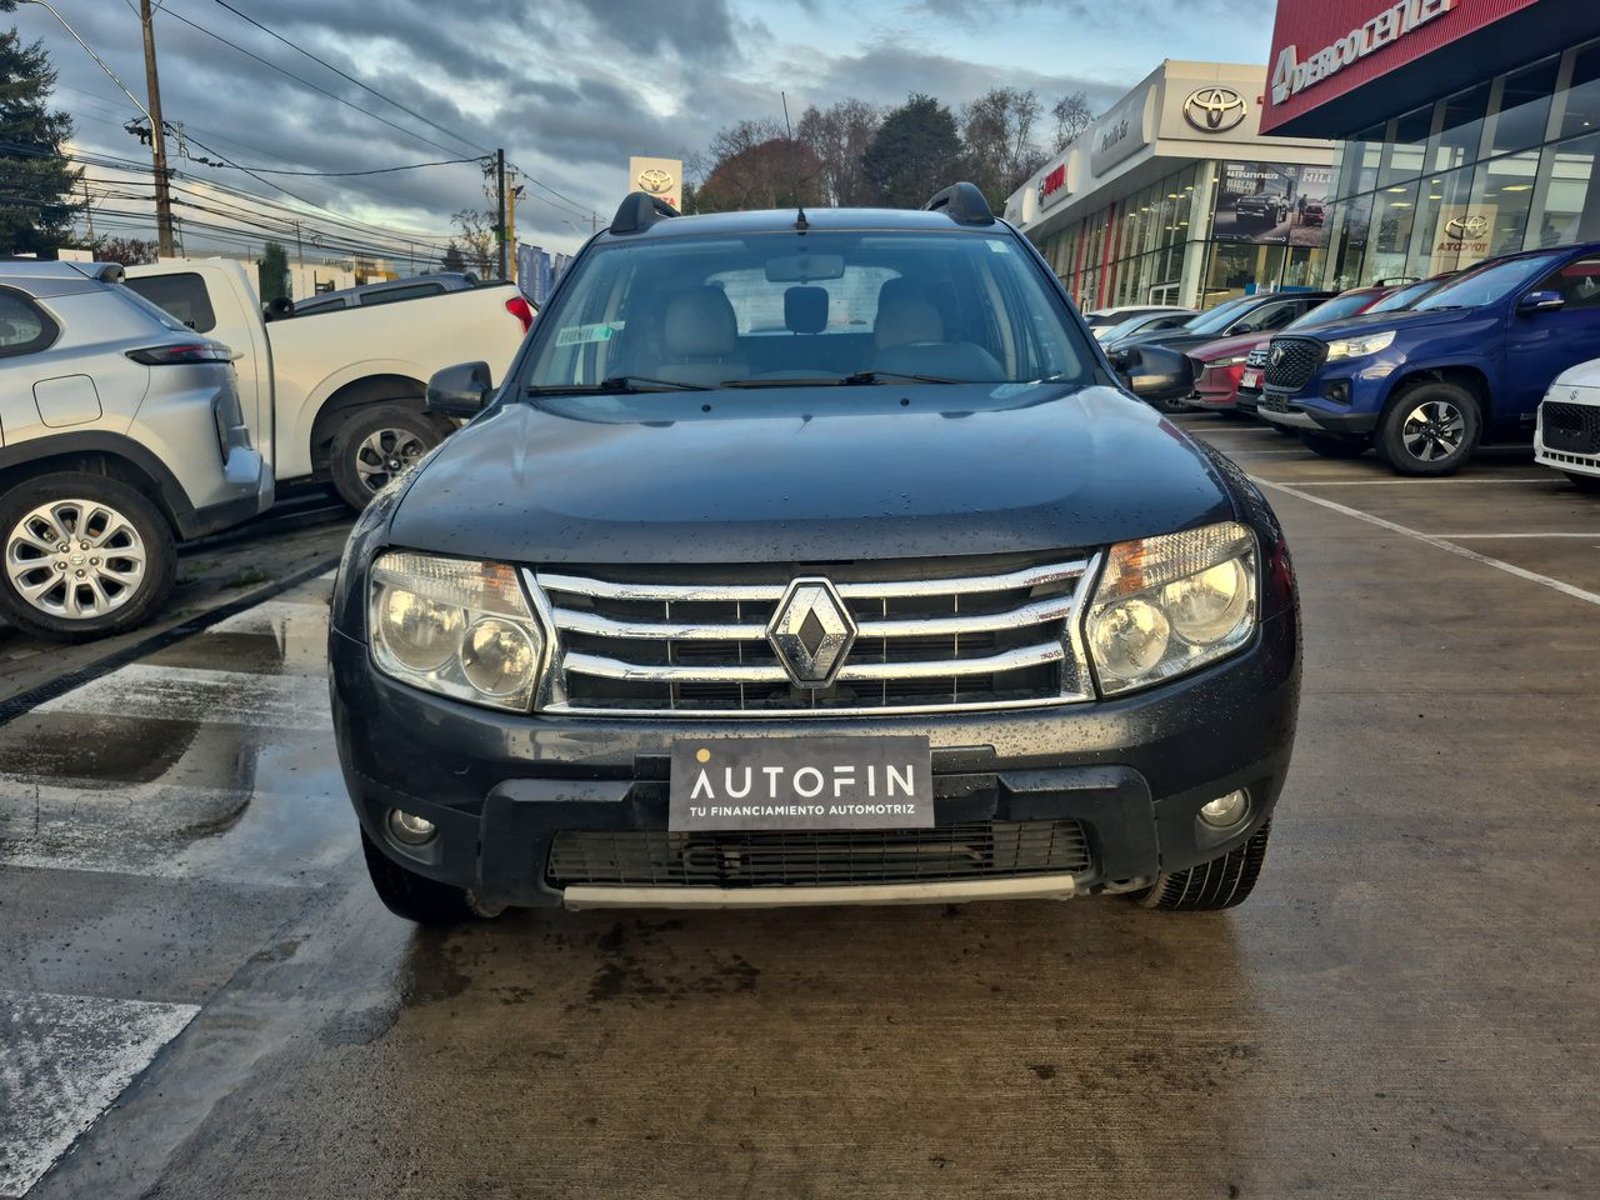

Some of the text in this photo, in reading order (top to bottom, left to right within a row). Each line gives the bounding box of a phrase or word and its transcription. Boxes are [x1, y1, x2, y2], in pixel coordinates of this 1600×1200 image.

[690, 765, 915, 799] AUTOFIN
[690, 804, 915, 817] TU FINANCIAMIENTO AUTOMOTRIZ
